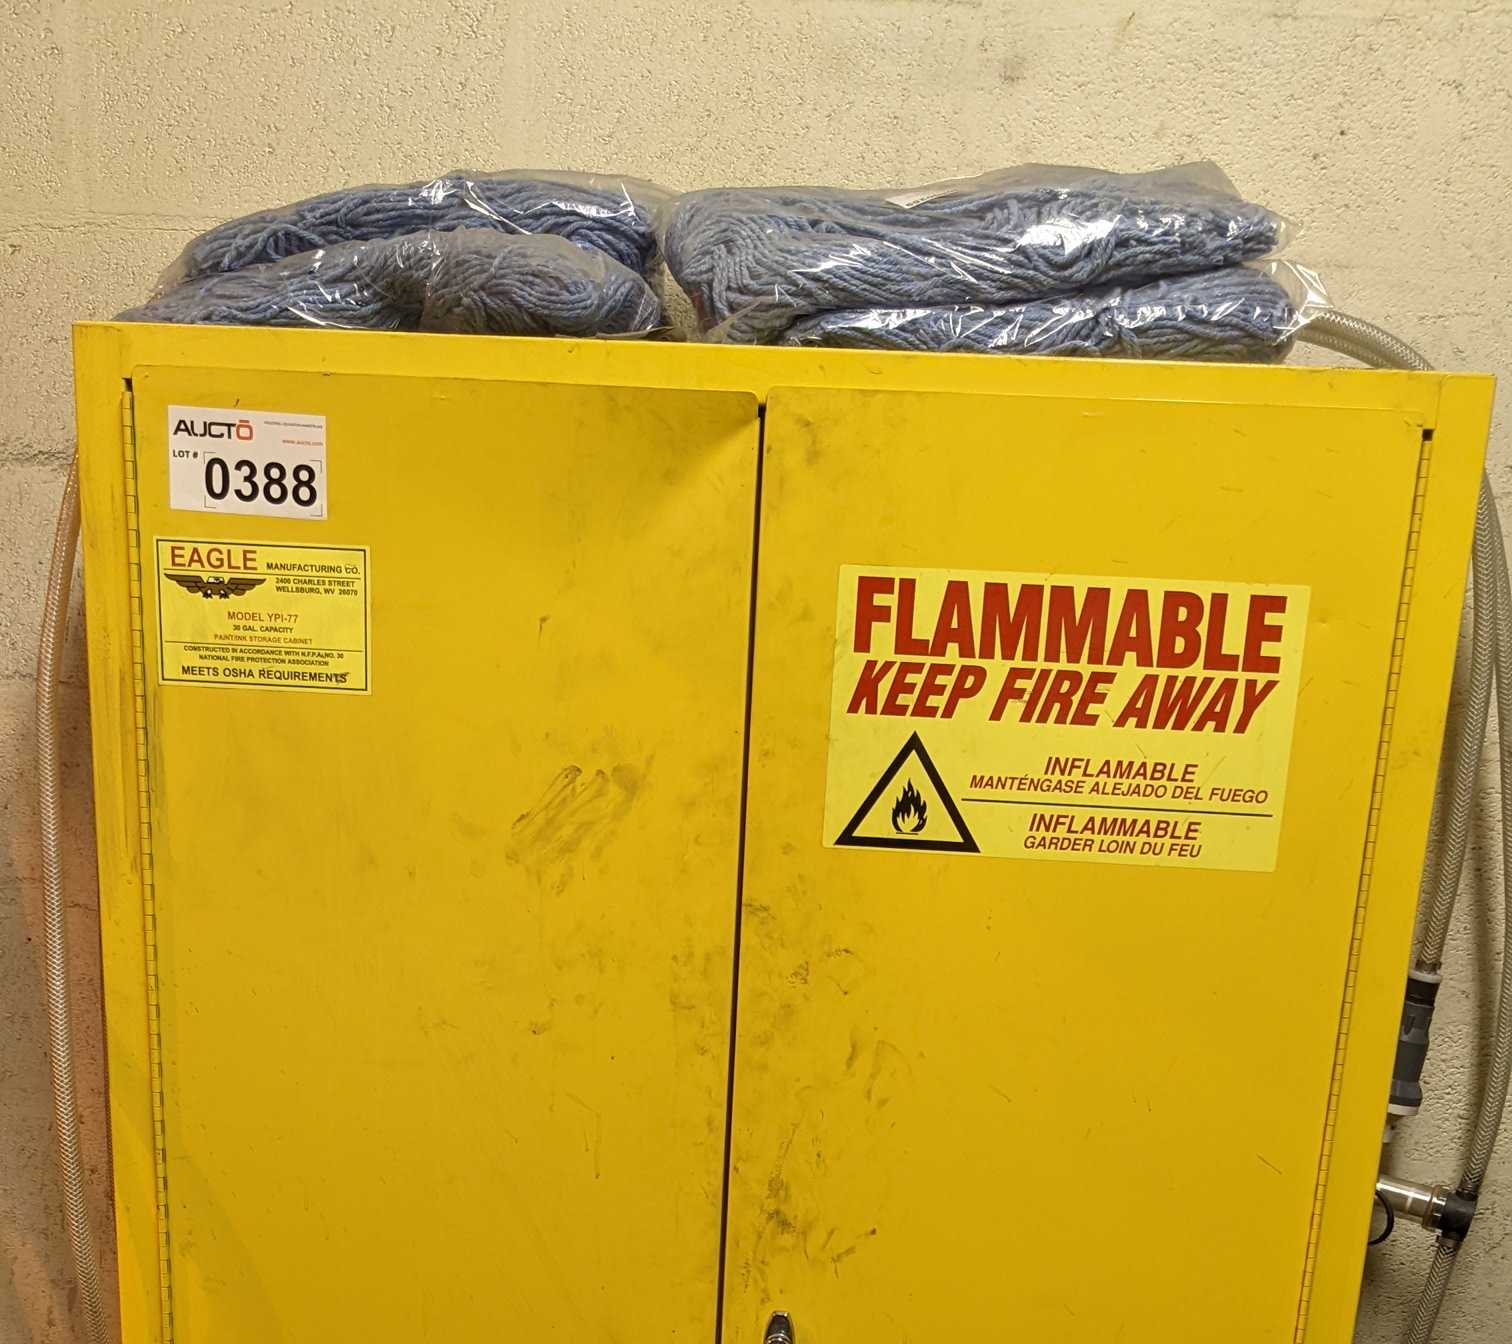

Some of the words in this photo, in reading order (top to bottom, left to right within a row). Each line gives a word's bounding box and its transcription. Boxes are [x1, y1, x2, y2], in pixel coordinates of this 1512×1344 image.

[172, 449, 190, 459] LOT
[192, 450, 199, 459] #
[205, 457, 317, 507] 0388
[170, 545, 258, 571] EAGLE
[266, 562, 342, 574] MANUFACTURING
[345, 566, 361, 575] CO.
[275, 586, 322, 595] WELLSBURG,
[292, 578, 327, 586] CHARLES
[327, 580, 355, 588] STREET
[227, 611, 264, 622] MODEL
[267, 613, 299, 624] YPI-77
[853, 575, 1287, 674] FLAMMABLE
[242, 624, 258, 633] GAL.
[259, 626, 294, 634] CAPACITY
[249, 635, 281, 644] STORAGE
[282, 637, 312, 645] CABINET
[183, 645, 231, 654] CONSTRUCTED
[238, 648, 283, 657] ACCORDANCE
[198, 654, 230, 662] NATIONAL
[287, 659, 329, 667] ASSOCIATION
[181, 665, 219, 677] MEETS
[222, 667, 255, 679] OSHA
[258, 669, 347, 683] REQUIREMENTS
[847, 659, 987, 719] KEEP
[988, 667, 1117, 728] FIRE
[1113, 673, 1280, 735] AWAY
[1043, 756, 1199, 783] INFLAMABLE
[969, 772, 1086, 794] MANTÉNGASE
[1088, 780, 1168, 800] ALEJADO
[1171, 786, 1204, 801] DEL
[1208, 787, 1269, 805] FUEGO
[1028, 812, 1202, 841] INFLAMMABLE
[1023, 835, 1095, 852] GARDER
[1099, 839, 1135, 855] LOIN
[1139, 843, 1164, 857] DU
[1167, 843, 1202, 859] FEU
